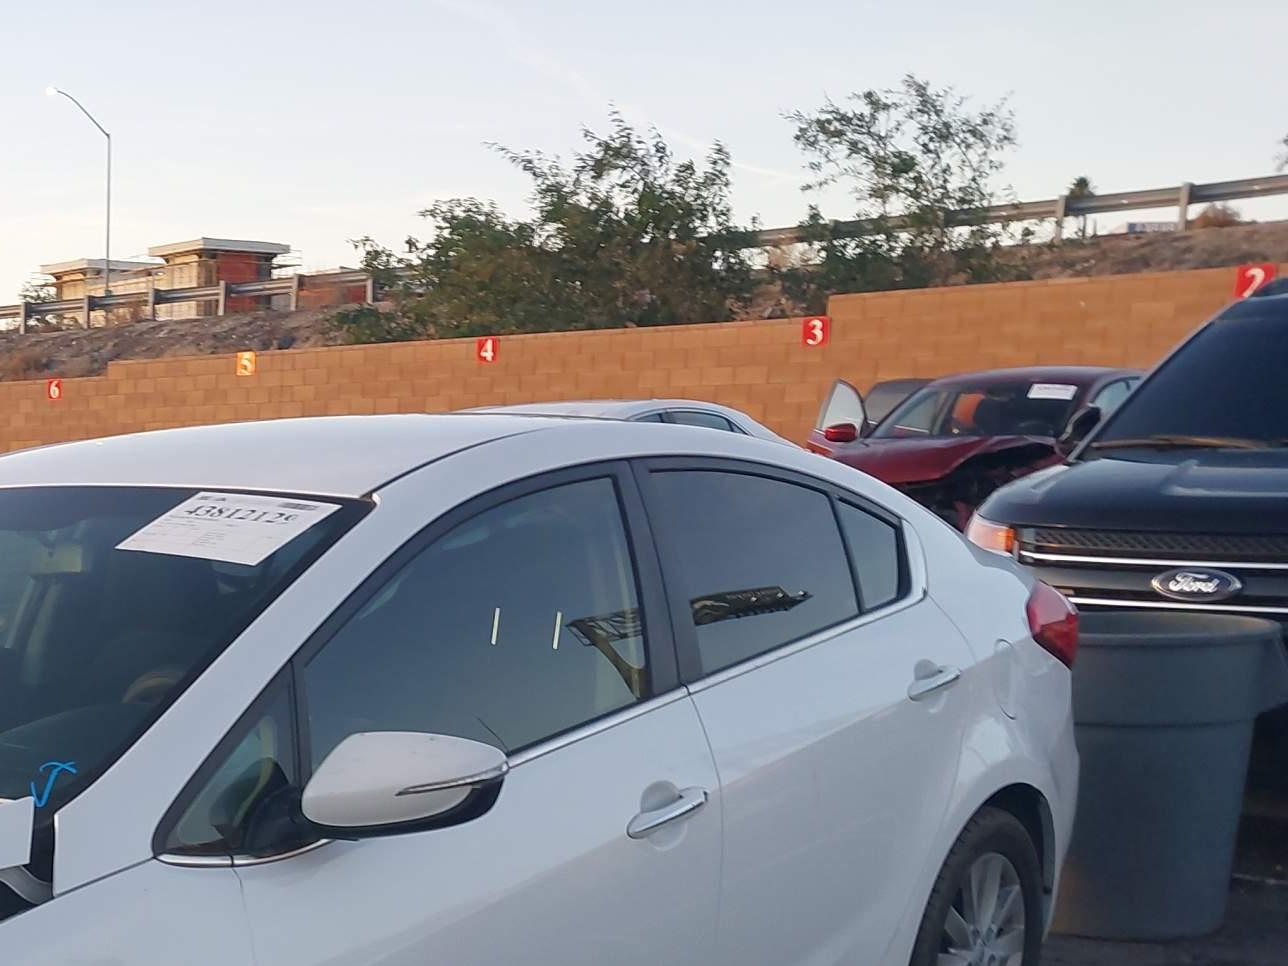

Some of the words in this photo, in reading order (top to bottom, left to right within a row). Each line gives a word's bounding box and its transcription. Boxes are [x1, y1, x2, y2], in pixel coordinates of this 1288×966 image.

[806, 318, 824, 345] 3
[480, 338, 494, 361] 4
[49, 379, 60, 399] 6
[1168, 572, 1220, 593] Ford
